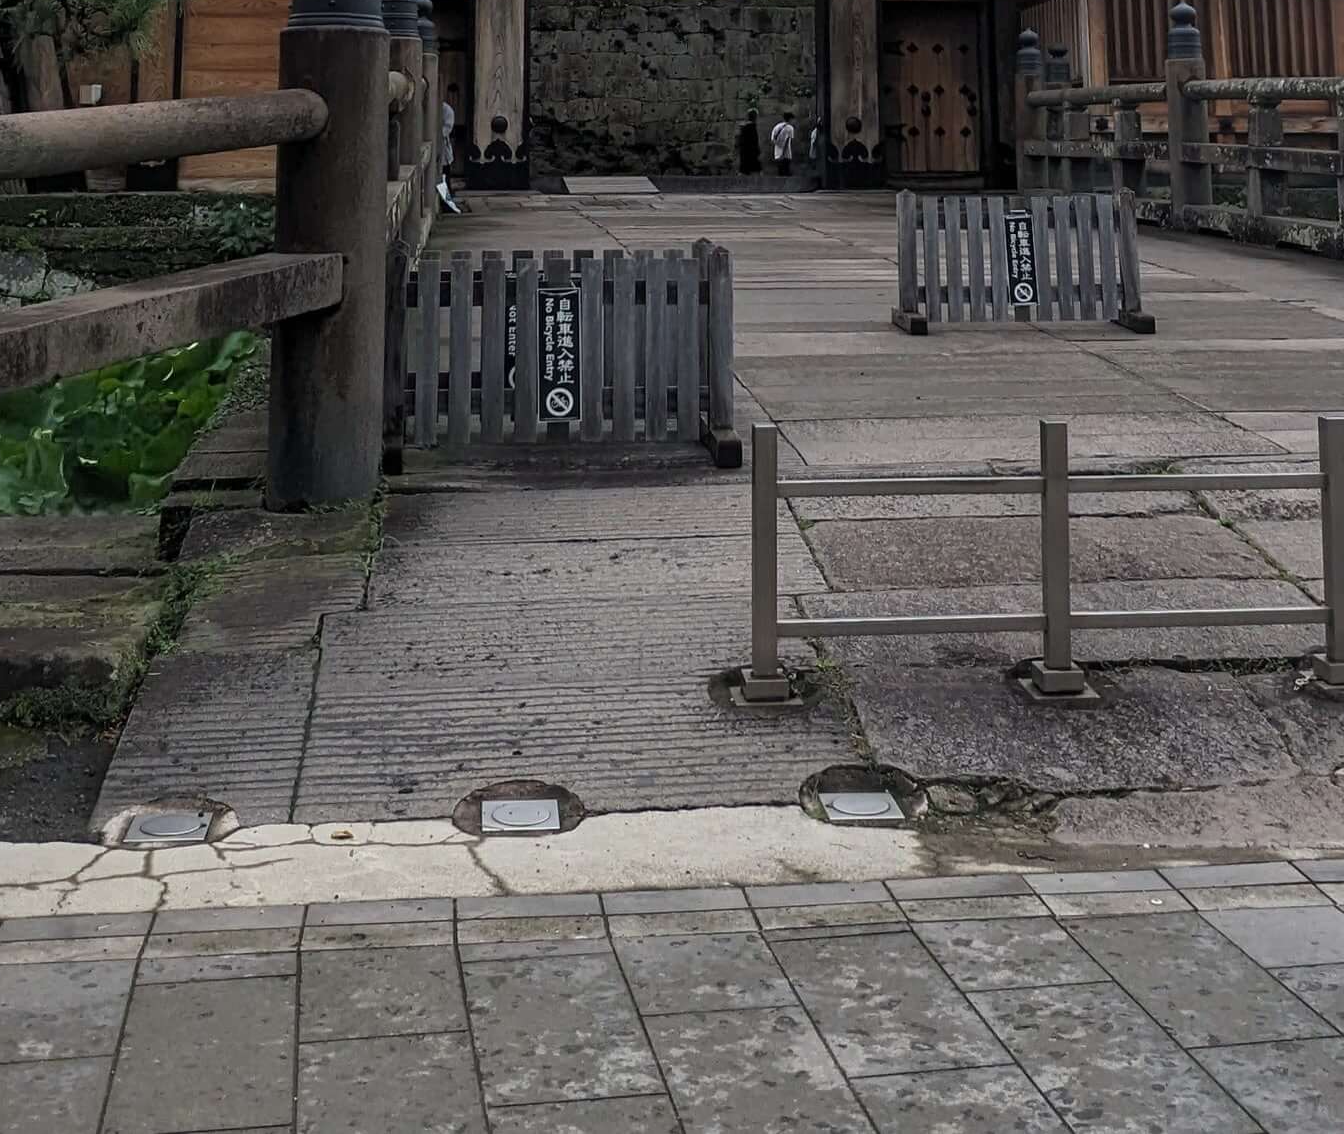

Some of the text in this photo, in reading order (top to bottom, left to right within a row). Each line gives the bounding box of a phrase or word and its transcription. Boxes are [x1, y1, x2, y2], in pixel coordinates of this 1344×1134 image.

[544, 298, 555, 381] No Bicycle Entry
[556, 298, 574, 384] 自転車進入禁止
